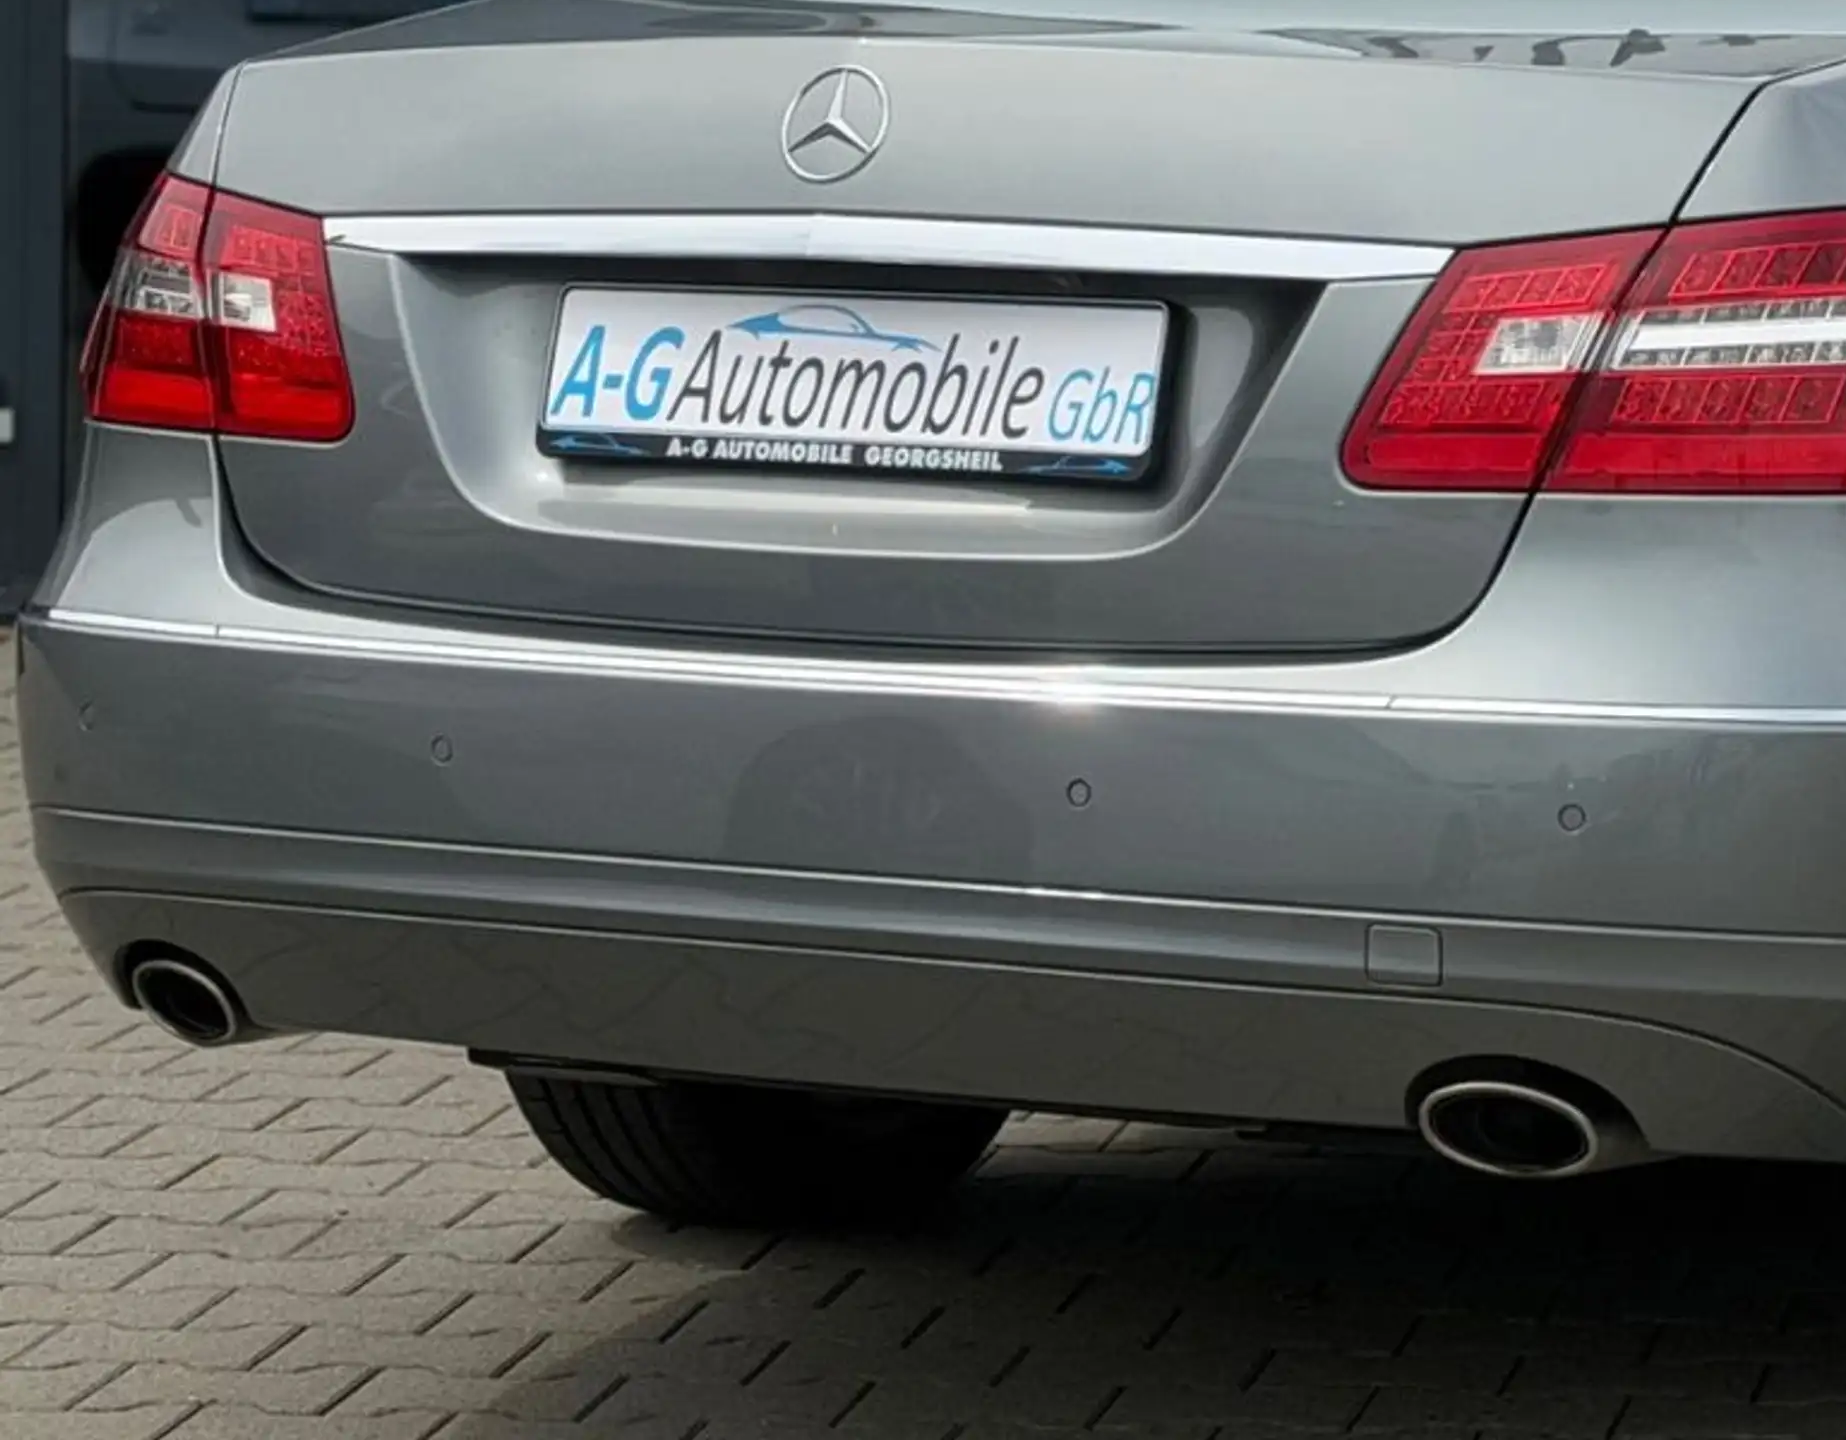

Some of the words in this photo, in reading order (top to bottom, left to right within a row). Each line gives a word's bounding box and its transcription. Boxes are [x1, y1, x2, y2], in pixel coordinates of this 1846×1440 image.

[551, 325, 685, 420] A-G
[667, 330, 1044, 438] Automobile
[1048, 367, 1155, 445] GbR
[666, 437, 708, 458] A-G
[713, 438, 852, 465] AUTOMOBILE
[864, 445, 1003, 472] GEORGSHEIL
